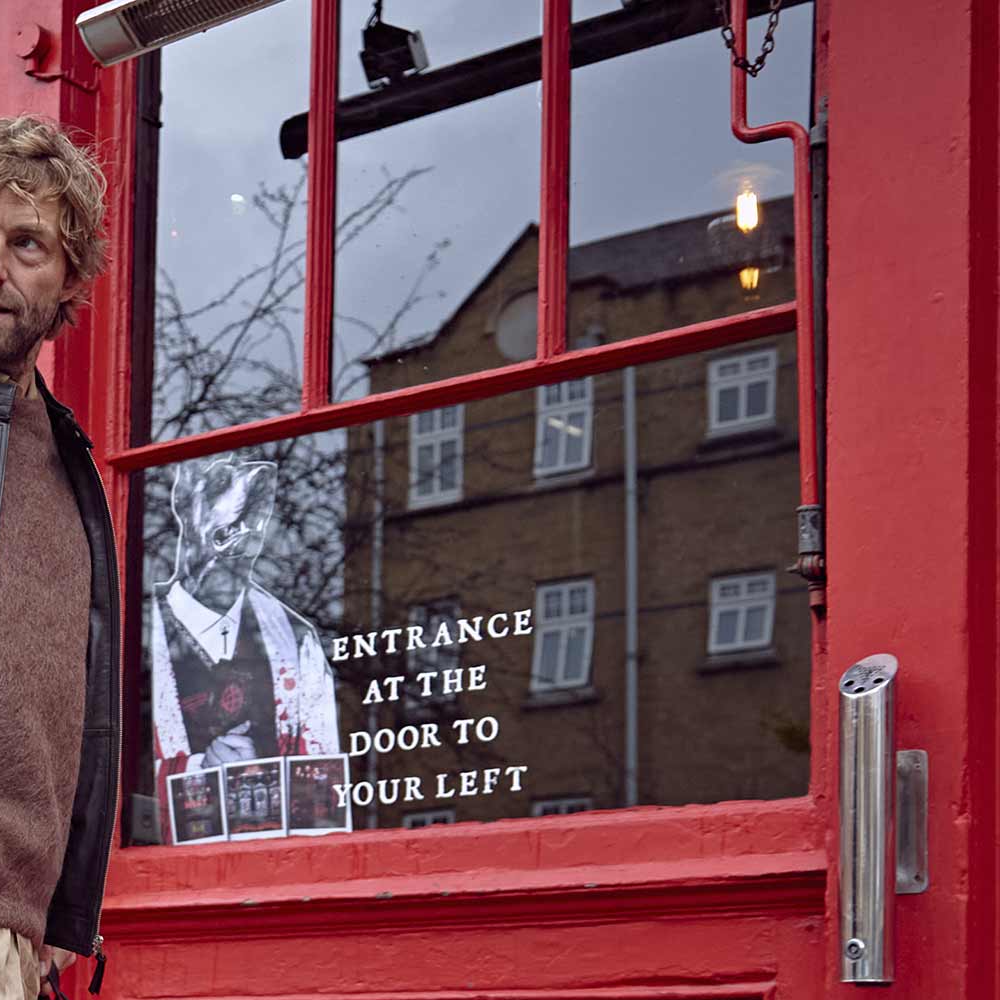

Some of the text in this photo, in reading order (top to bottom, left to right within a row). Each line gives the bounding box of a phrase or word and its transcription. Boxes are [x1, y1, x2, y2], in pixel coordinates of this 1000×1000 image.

[332, 609, 533, 662] ENTRANCE
[362, 665, 487, 705] AT THE
[349, 716, 499, 757] DOOR TO
[333, 766, 528, 808] YOUR LEFT
